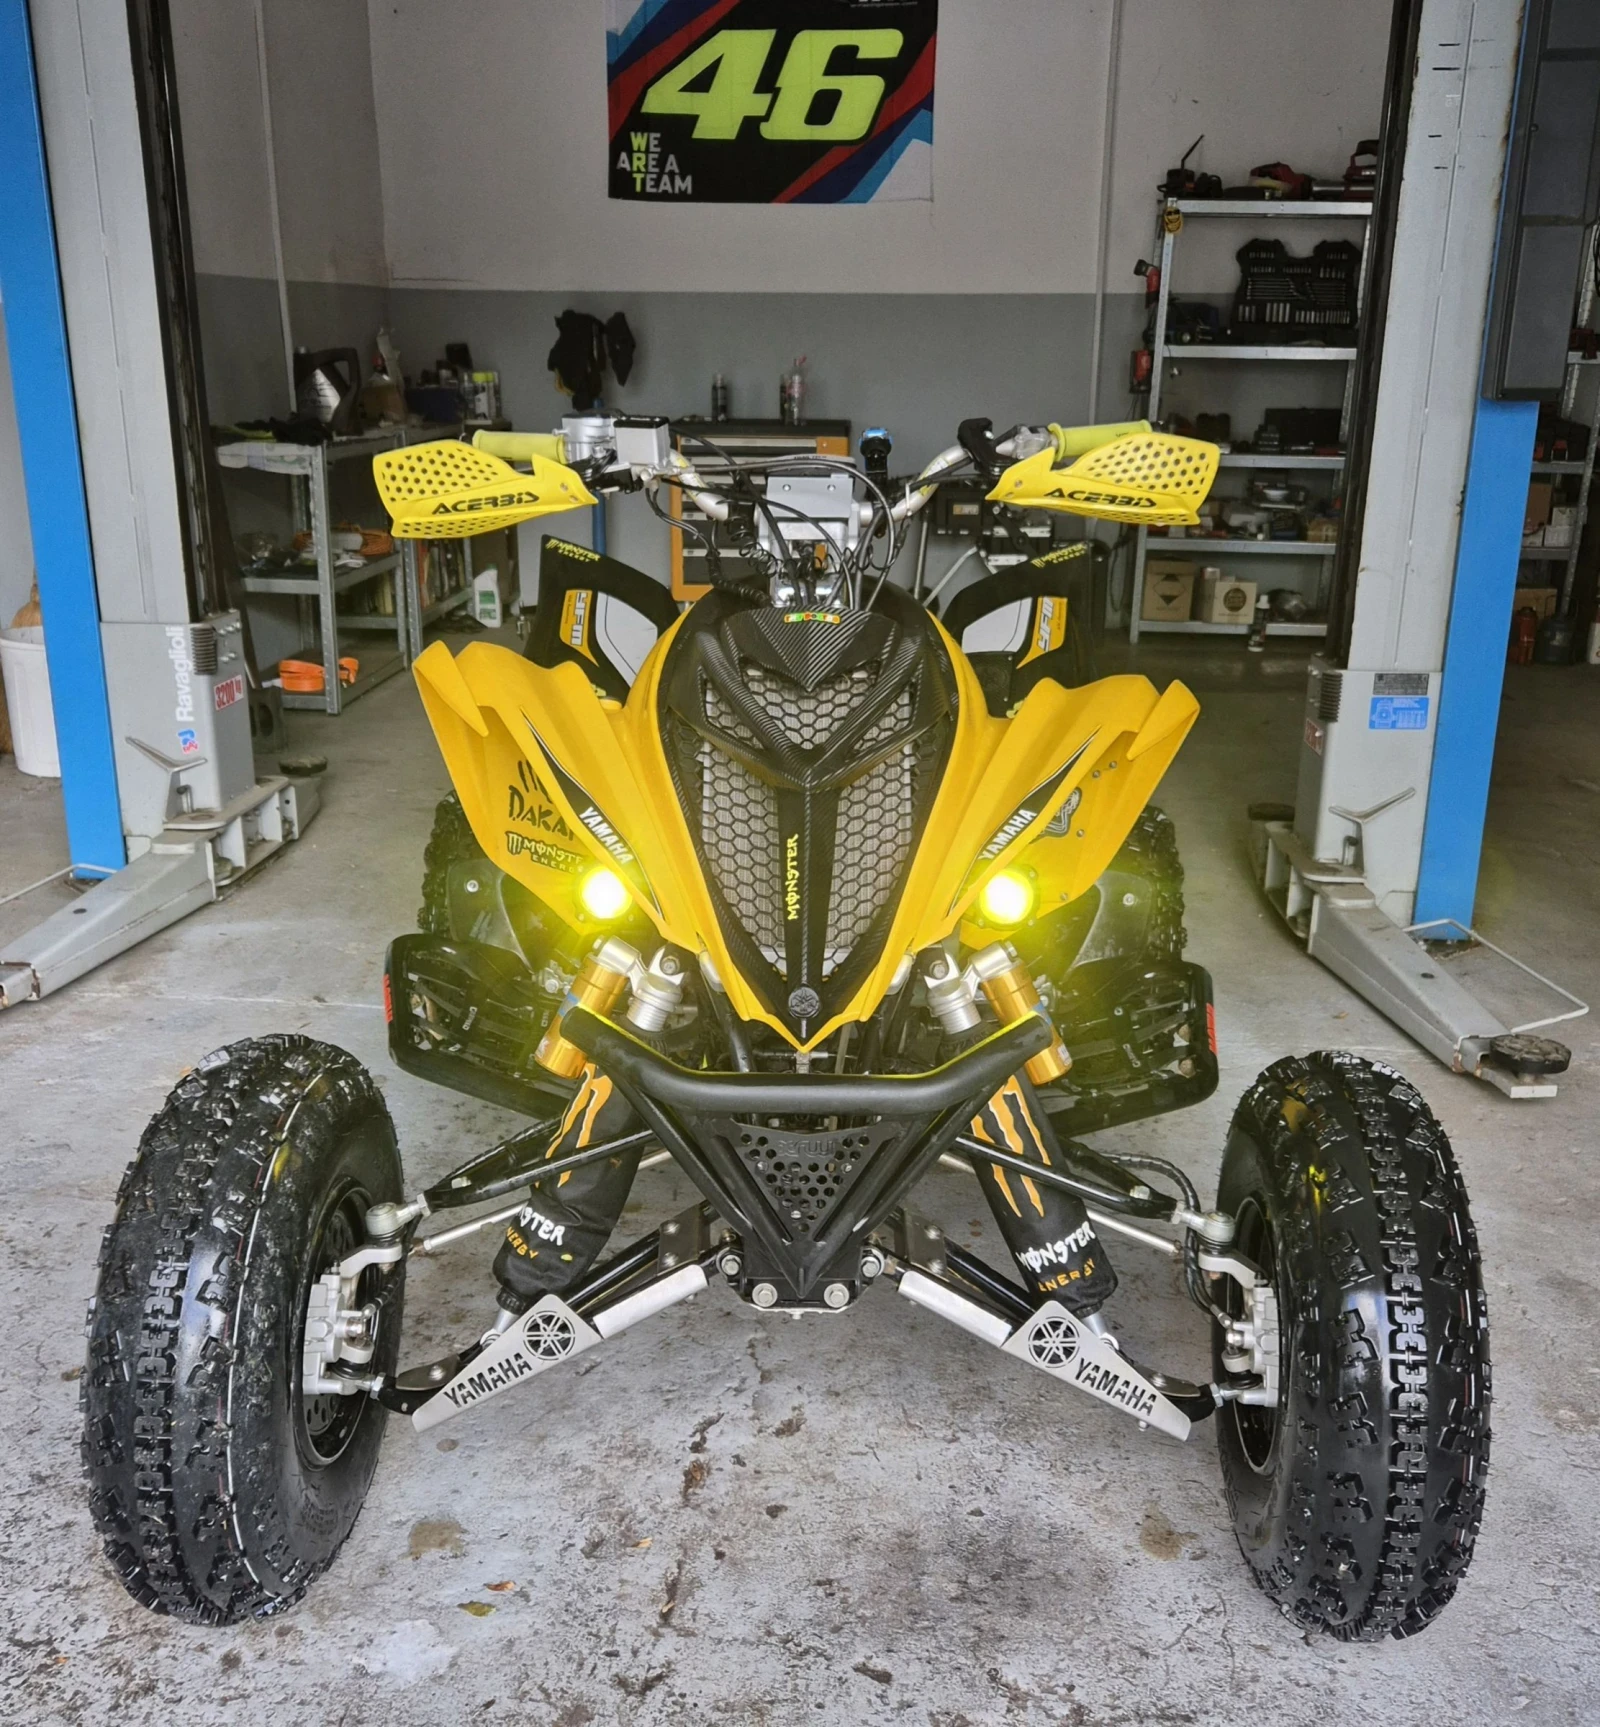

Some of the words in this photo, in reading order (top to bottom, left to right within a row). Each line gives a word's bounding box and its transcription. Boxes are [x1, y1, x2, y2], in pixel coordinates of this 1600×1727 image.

[640, 28, 904, 140] 46
[616, 151, 660, 173] ARE
[664, 153, 680, 174] A
[630, 131, 661, 153] WE
[631, 173, 692, 195] TEAM
[432, 490, 540, 516] ACERBIS
[1043, 487, 1157, 509] ACERBIS
[166, 625, 195, 722] Ravaglioli
[215, 680, 235, 709] 3200
[508, 785, 575, 841] DAKA
[579, 806, 635, 864] YAMAHA
[977, 808, 1038, 861] YAMAHA
[520, 1206, 566, 1247] STER
[443, 1352, 534, 1410] YAMAHA
[1073, 1356, 1158, 1417] YAMAHA
